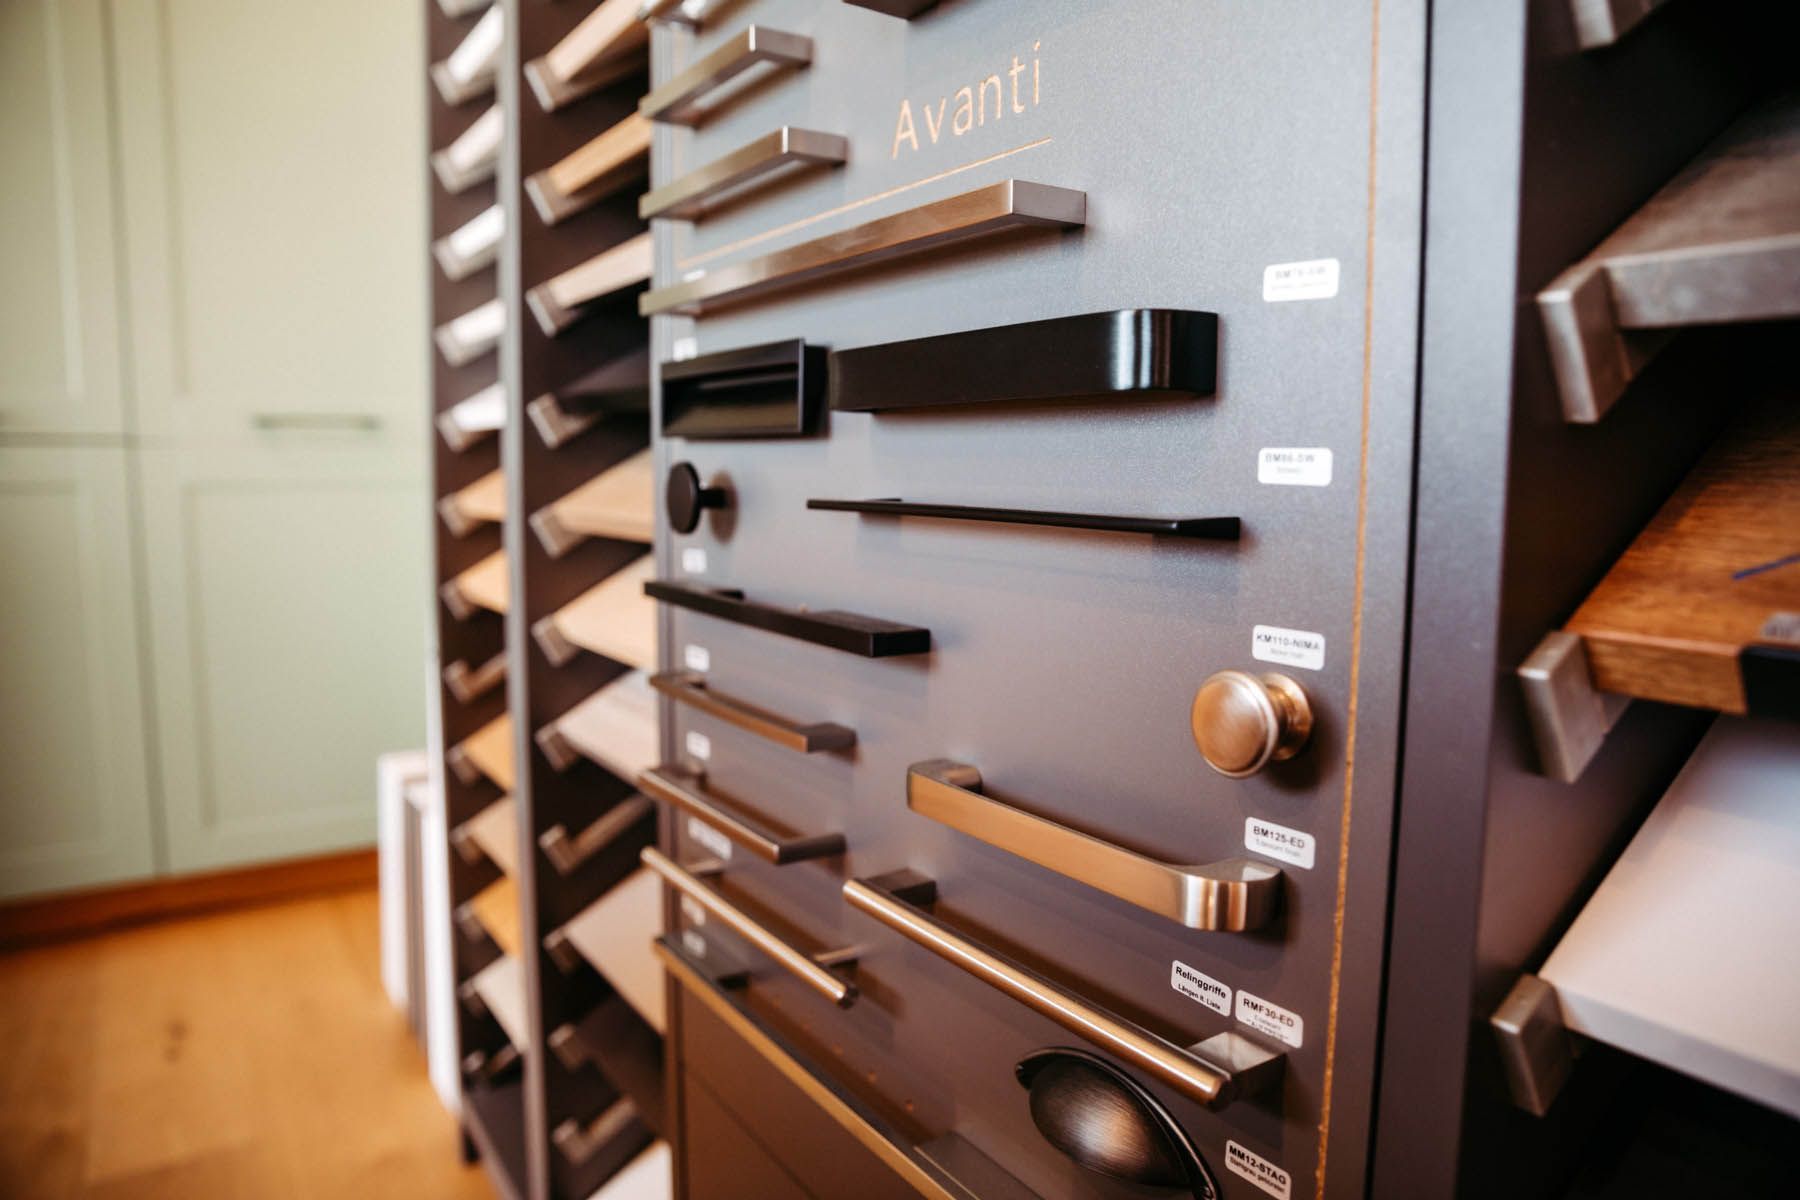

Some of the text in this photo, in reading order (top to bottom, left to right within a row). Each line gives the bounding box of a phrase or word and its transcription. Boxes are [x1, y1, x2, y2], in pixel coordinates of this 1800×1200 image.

[890, 39, 1042, 161] Avanti
[1253, 825, 1305, 849] BM125-ED
[1175, 966, 1226, 999] Relinggriffe
[1243, 997, 1295, 1028] RMF30-ED
